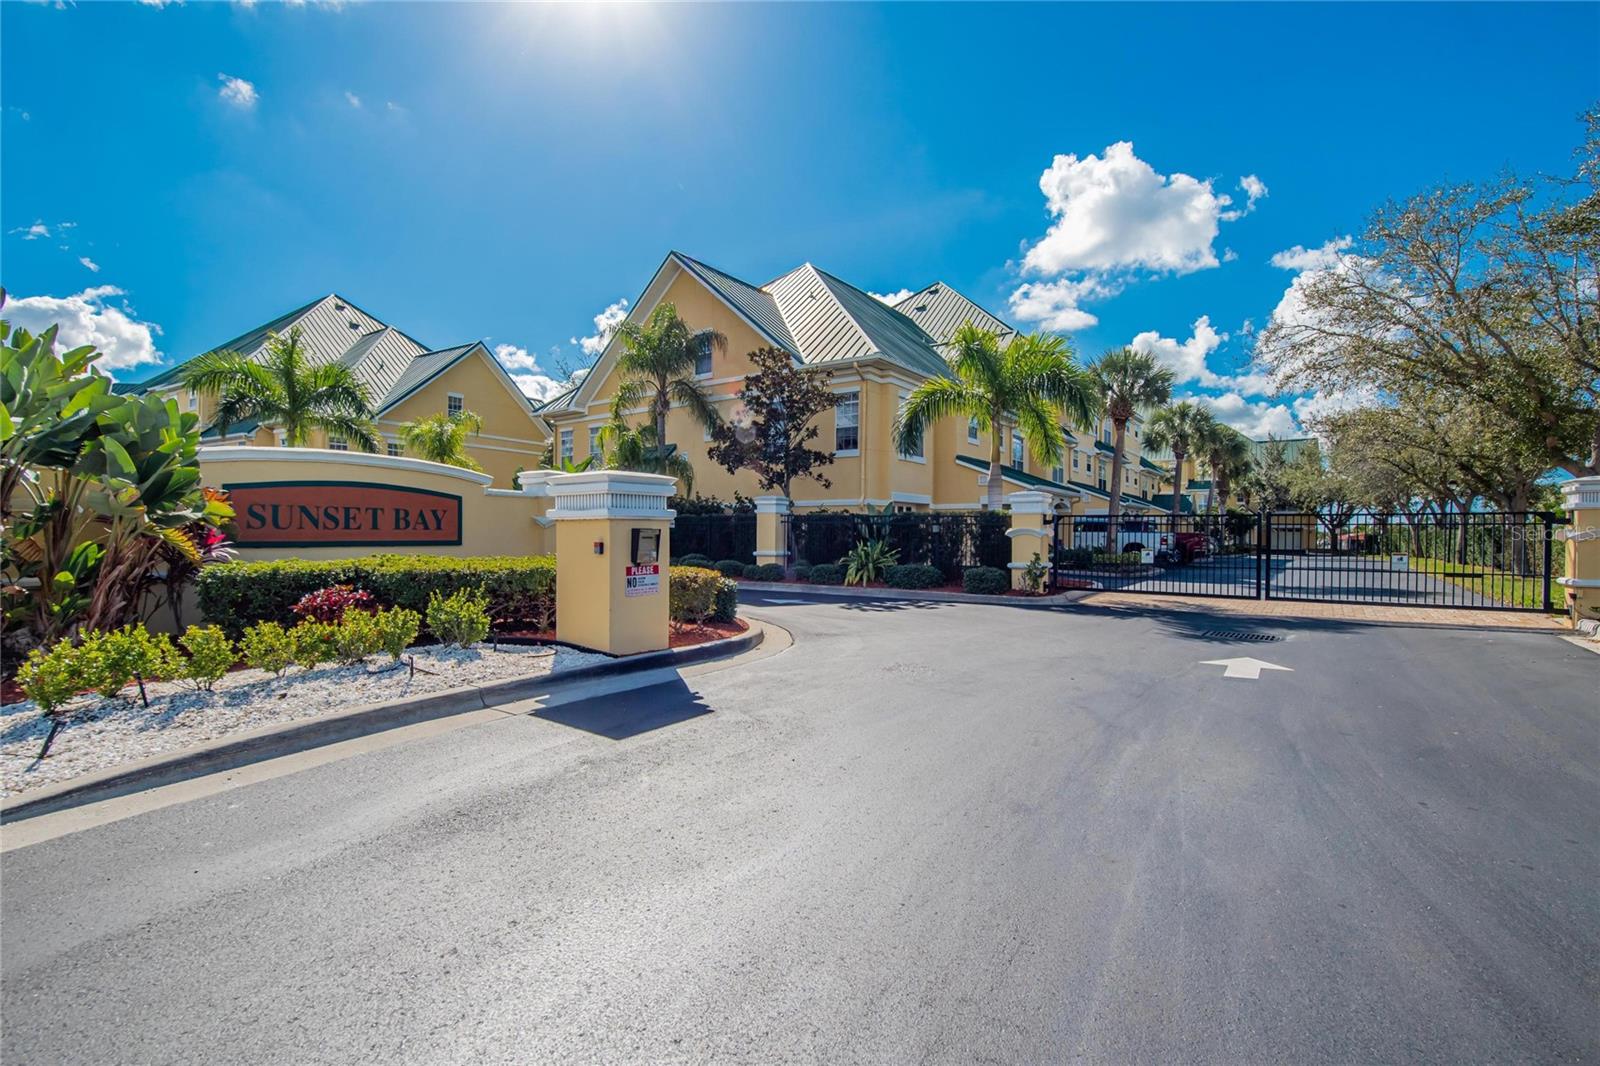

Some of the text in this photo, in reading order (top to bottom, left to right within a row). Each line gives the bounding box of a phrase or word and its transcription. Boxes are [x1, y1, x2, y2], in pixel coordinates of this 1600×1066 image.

[246, 503, 449, 531] SUNSET BAY
[631, 565, 654, 576] PLEASE
[626, 577, 637, 589] NO
